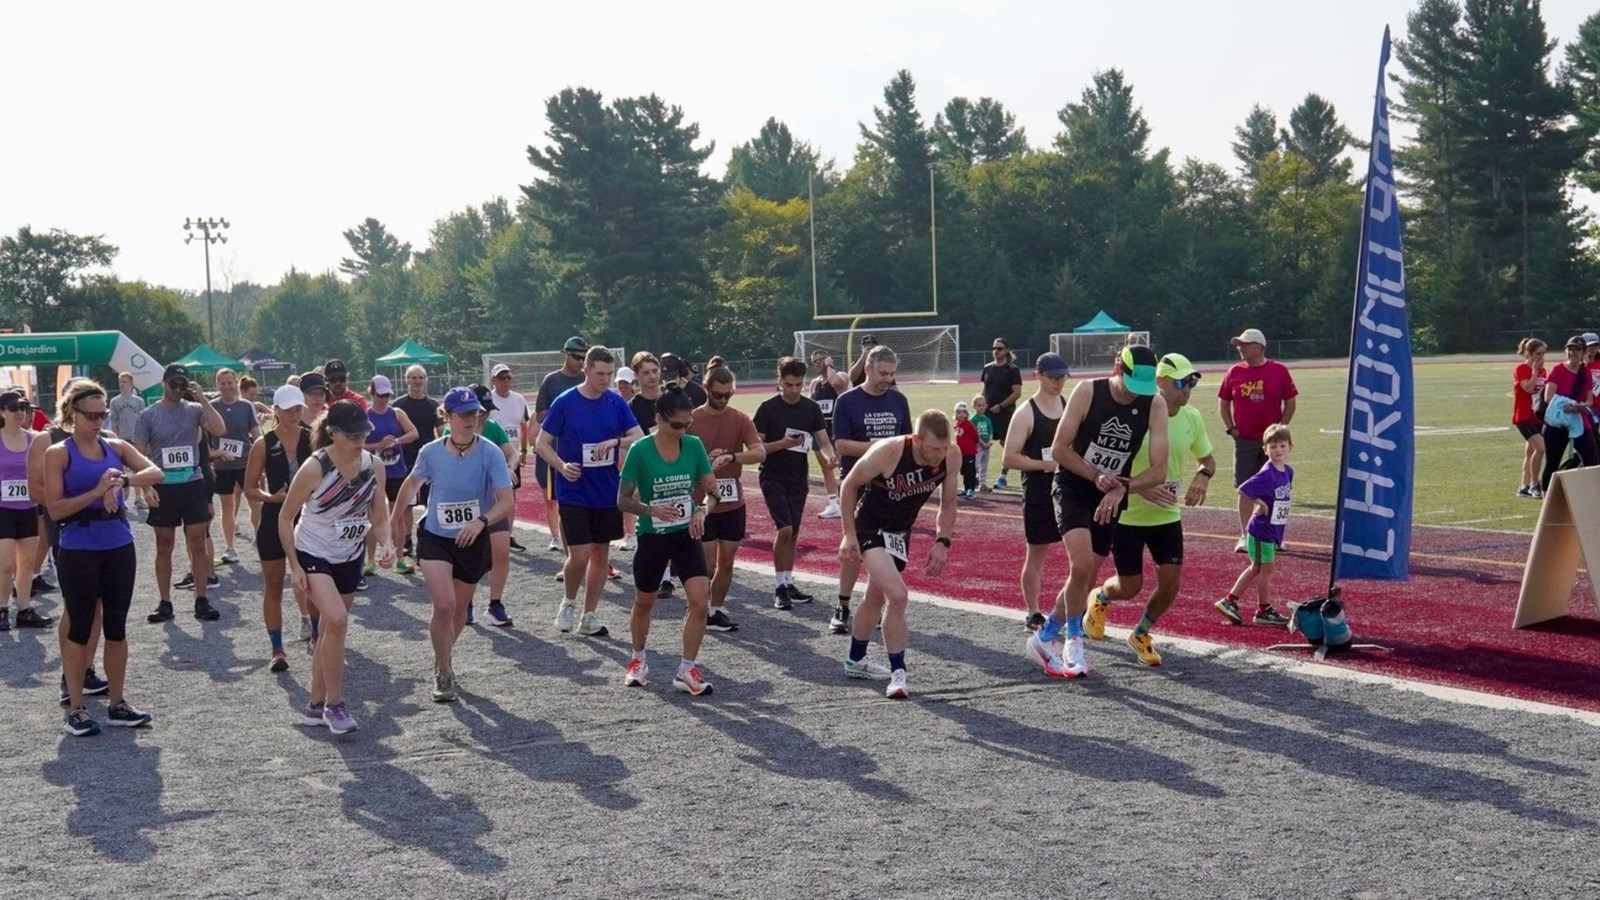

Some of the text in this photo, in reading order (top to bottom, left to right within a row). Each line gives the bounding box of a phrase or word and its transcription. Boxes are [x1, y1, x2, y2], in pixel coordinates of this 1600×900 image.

[7, 344, 57, 356] Desjardins
[223, 442, 238, 454] 278
[168, 451, 189, 463] 060
[1091, 452, 1121, 471] 340
[665, 473, 690, 483] COURSE
[885, 468, 924, 492] BART
[8, 485, 27, 497] 270
[719, 484, 733, 497] 29
[888, 482, 936, 502] COACHING
[444, 507, 474, 524] 386
[340, 524, 366, 539] 209
[888, 535, 904, 554] 365
